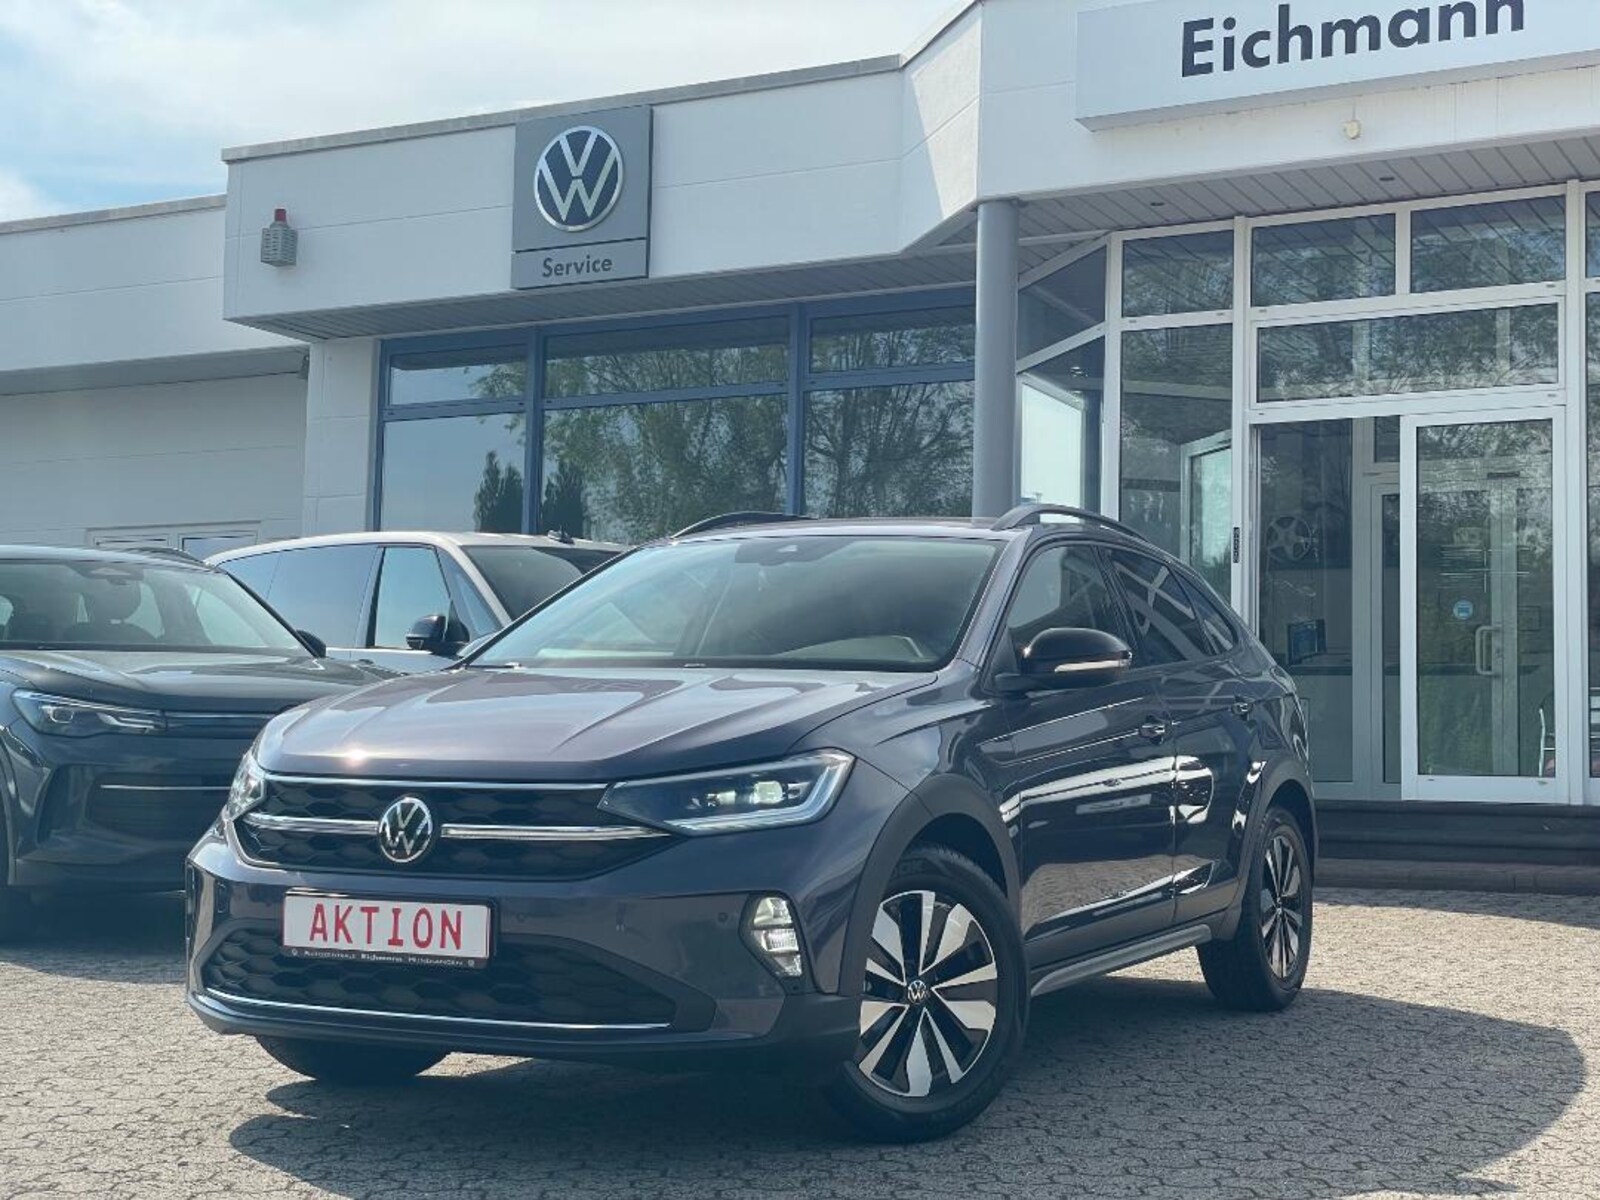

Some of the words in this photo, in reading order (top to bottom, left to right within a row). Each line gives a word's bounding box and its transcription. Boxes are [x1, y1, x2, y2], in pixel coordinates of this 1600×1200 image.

[1181, 0, 1525, 77] Eichmann
[536, 128, 620, 225] VW
[542, 255, 612, 277] Service
[379, 797, 432, 862] VW
[309, 903, 463, 949] AKTION
